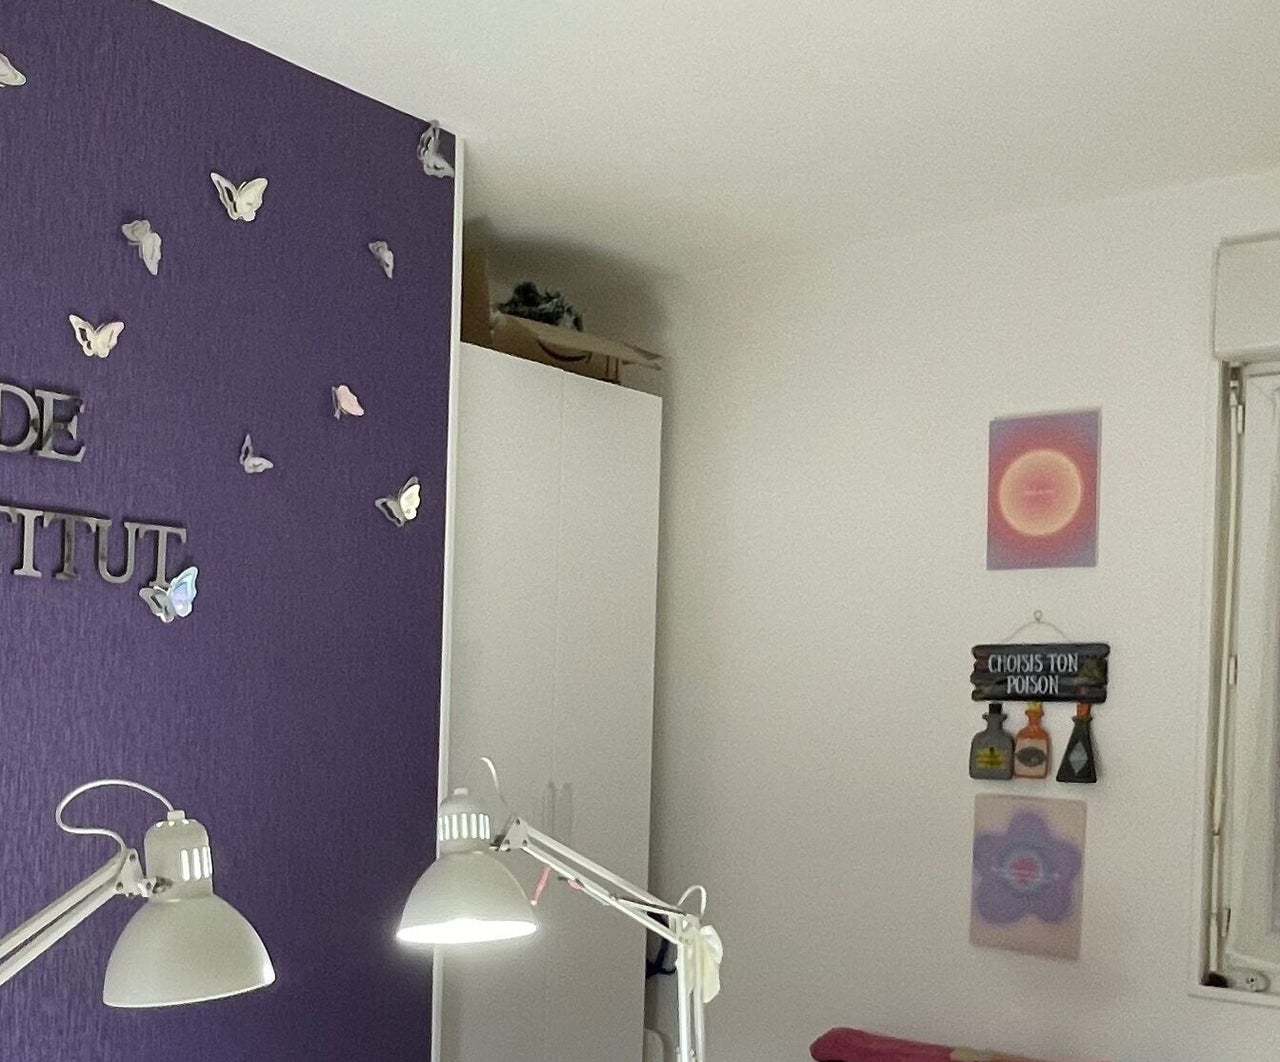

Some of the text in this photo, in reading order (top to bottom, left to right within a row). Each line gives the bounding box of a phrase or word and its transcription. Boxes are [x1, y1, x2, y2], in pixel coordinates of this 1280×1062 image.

[988, 652, 1079, 673] CHOISIS TON
[1006, 674, 1059, 695] POISON
